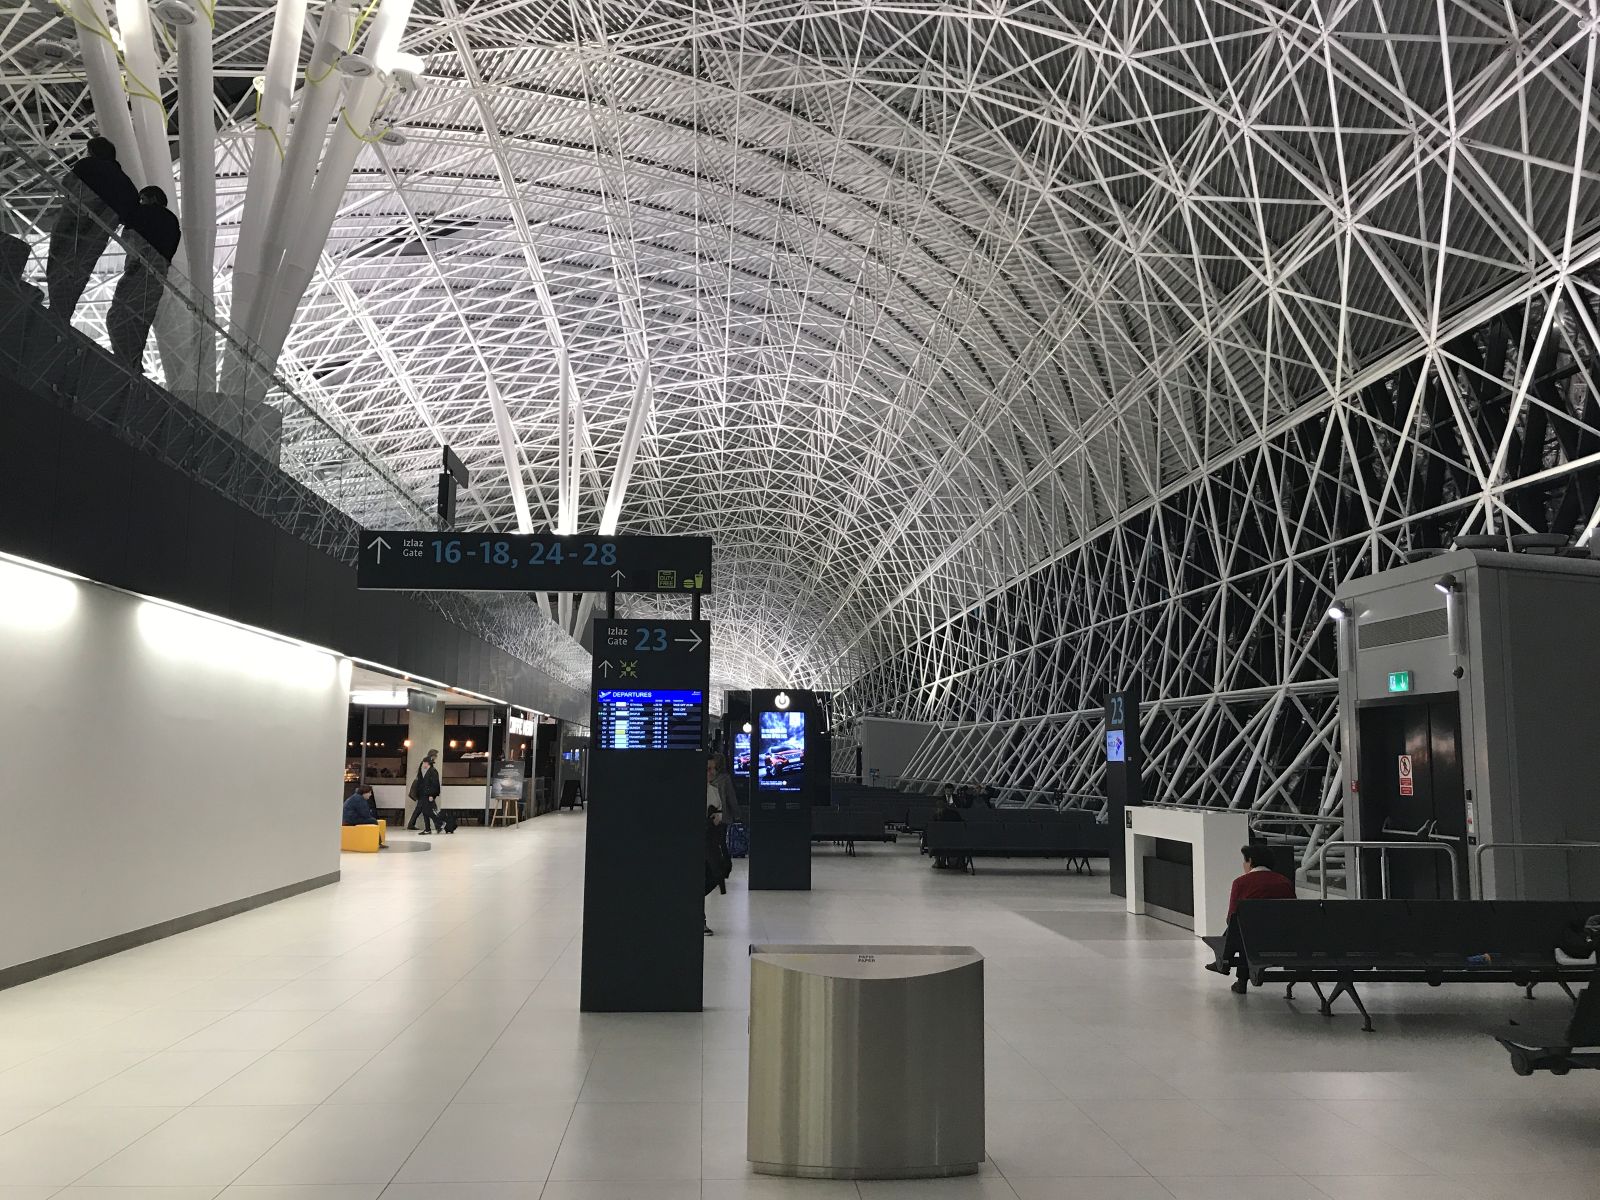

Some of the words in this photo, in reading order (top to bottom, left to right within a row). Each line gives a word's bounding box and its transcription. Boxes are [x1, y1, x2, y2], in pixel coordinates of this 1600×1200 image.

[403, 539, 424, 547] Izlaz
[402, 549, 423, 557] Gate
[528, 541, 617, 566] 24-28
[608, 627, 628, 636] Izlaz
[607, 637, 628, 646] Gate
[634, 628, 668, 651] 23
[1111, 696, 1123, 725] 23
